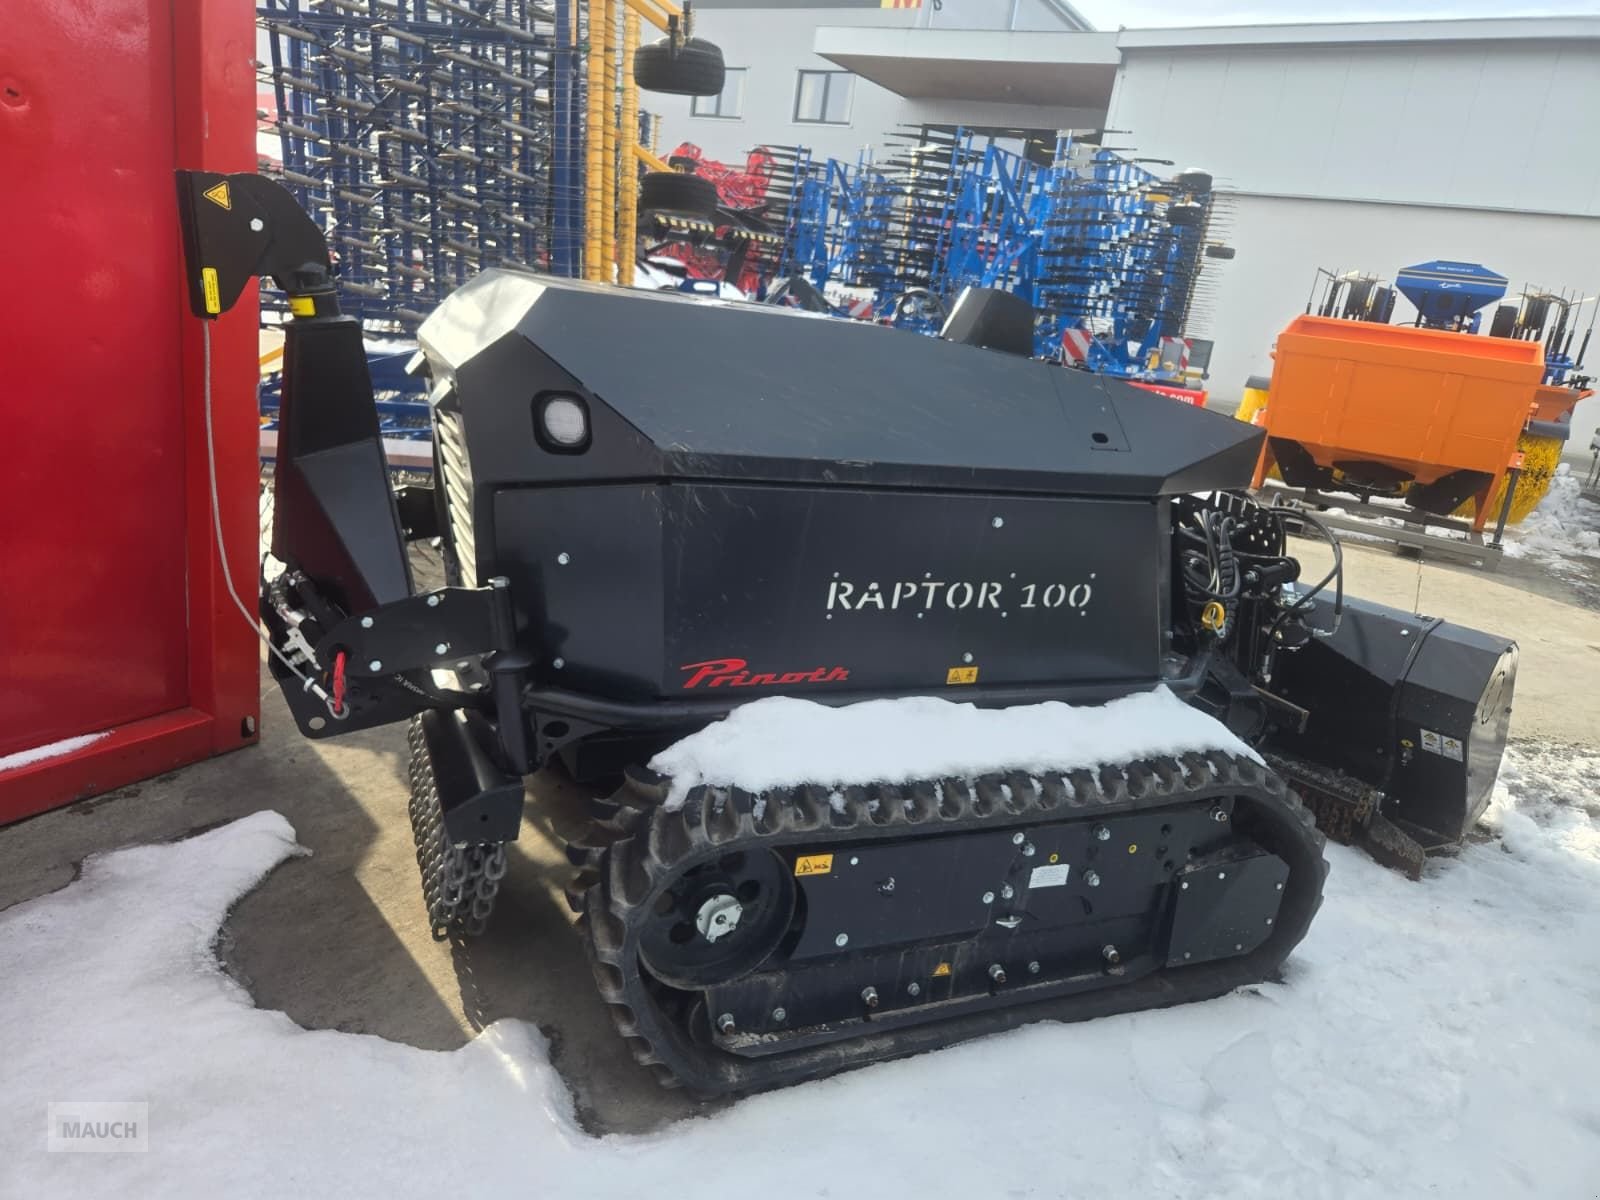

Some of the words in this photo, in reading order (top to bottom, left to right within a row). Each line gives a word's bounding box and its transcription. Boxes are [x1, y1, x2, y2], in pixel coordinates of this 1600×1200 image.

[826, 581, 1002, 610] RAPTOR
[1020, 583, 1092, 608] 100
[681, 658, 849, 688] Prinoth
